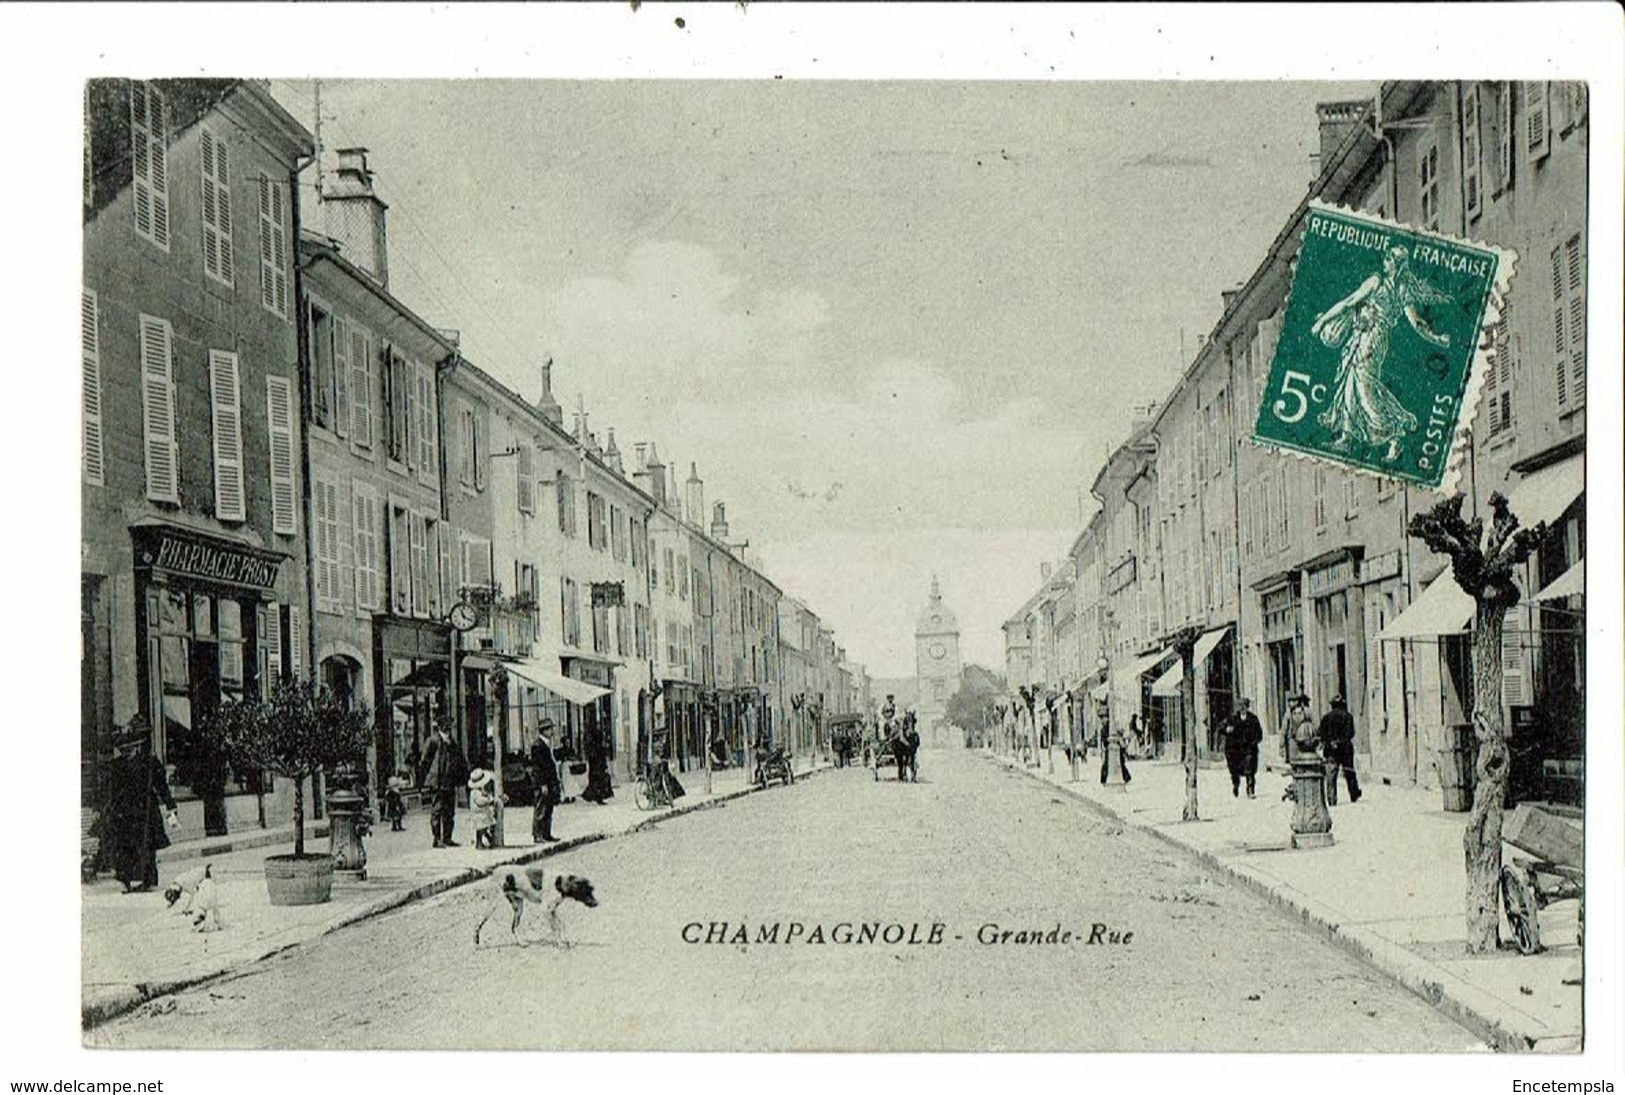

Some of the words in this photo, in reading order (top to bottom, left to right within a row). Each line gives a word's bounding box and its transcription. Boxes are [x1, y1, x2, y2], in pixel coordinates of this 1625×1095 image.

[1412, 243, 1490, 278] FRANÇAISE
[1418, 393, 1453, 470] POSTES
[156, 537, 240, 580] PHARMACIE
[237, 555, 280, 587] PROST
